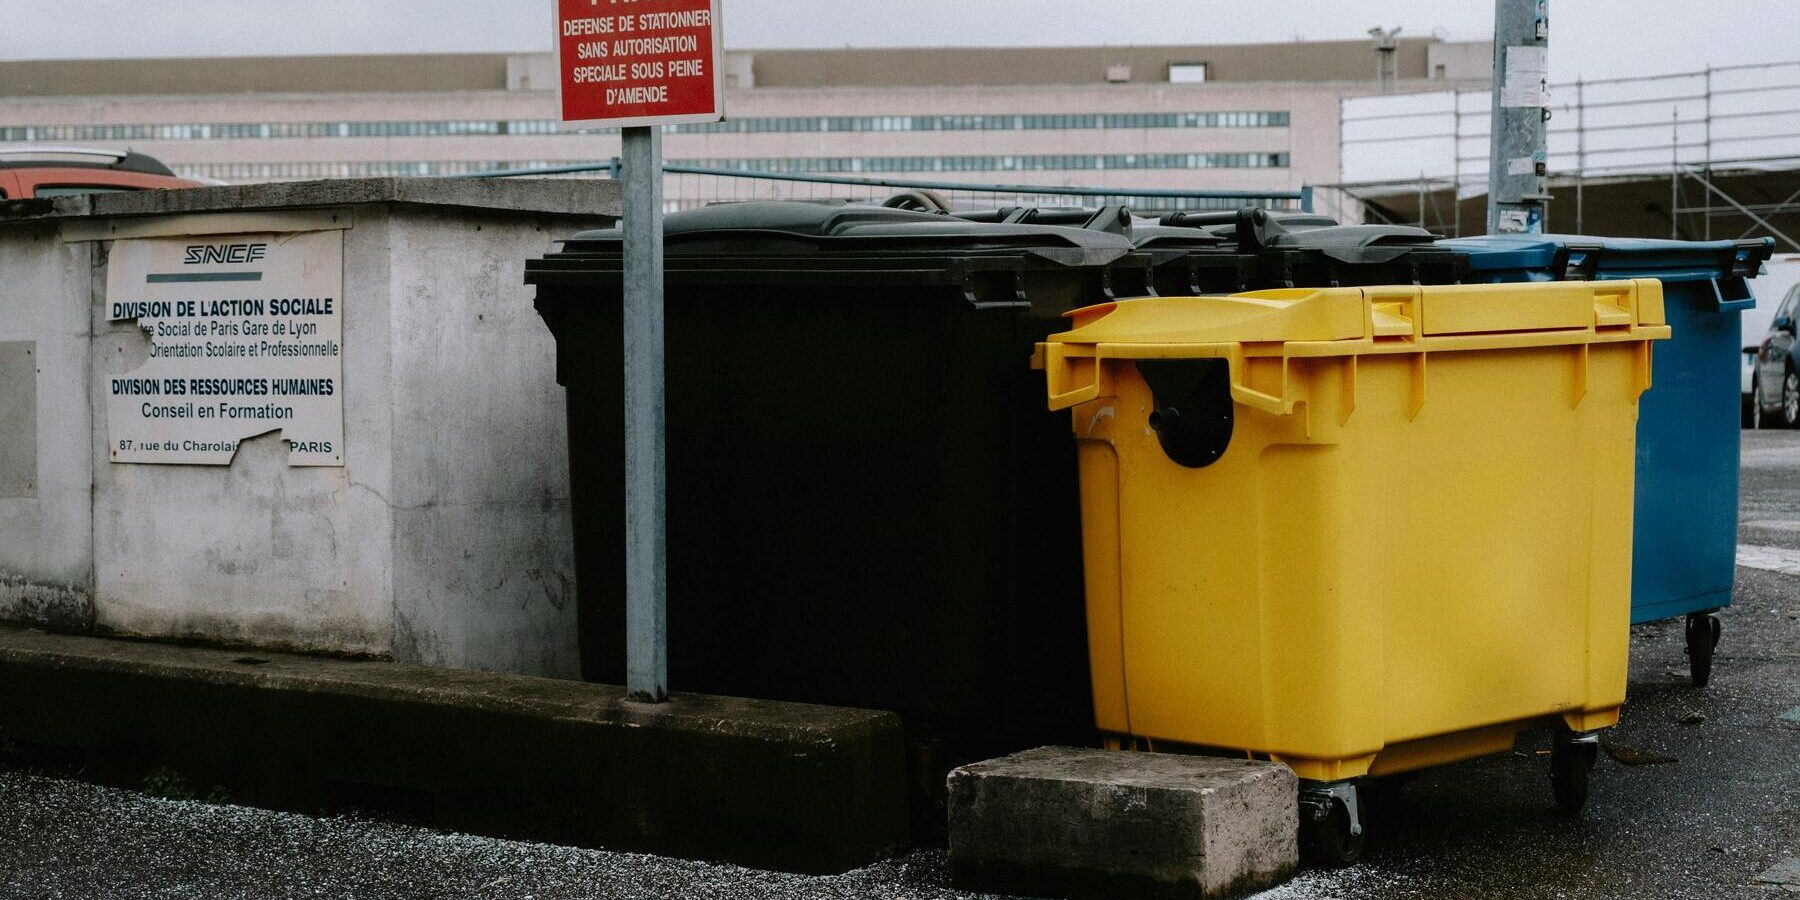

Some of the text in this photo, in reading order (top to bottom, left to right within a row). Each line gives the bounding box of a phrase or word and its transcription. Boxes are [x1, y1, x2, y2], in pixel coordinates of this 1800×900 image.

[564, 10, 710, 36] DEFENSE DE STATIONNER
[578, 35, 696, 59] SANS AUTORISATION
[574, 59, 702, 83] SPECIALE SOUS PEINE
[607, 86, 667, 105] D'AMENDE
[184, 244, 267, 264] SNCF
[113, 301, 171, 318] DIVISION
[177, 301, 195, 317] DE
[270, 298, 333, 315] SOCIALE
[158, 322, 190, 336] Social
[195, 321, 207, 336] de
[211, 321, 238, 335] Paris
[242, 320, 268, 335] Gare
[272, 320, 285, 334] de
[289, 319, 316, 338] Lyon
[206, 342, 245, 357] Scolaire
[249, 342, 257, 357] et
[261, 342, 338, 357] Professionnelle
[112, 379, 333, 396] DIVISION DES RESSOURCES HUMAINES
[142, 403, 293, 419] Conseil en Formation
[140, 442, 159, 451] rue
[163, 441, 179, 451] du
[290, 442, 332, 453] PARIS
